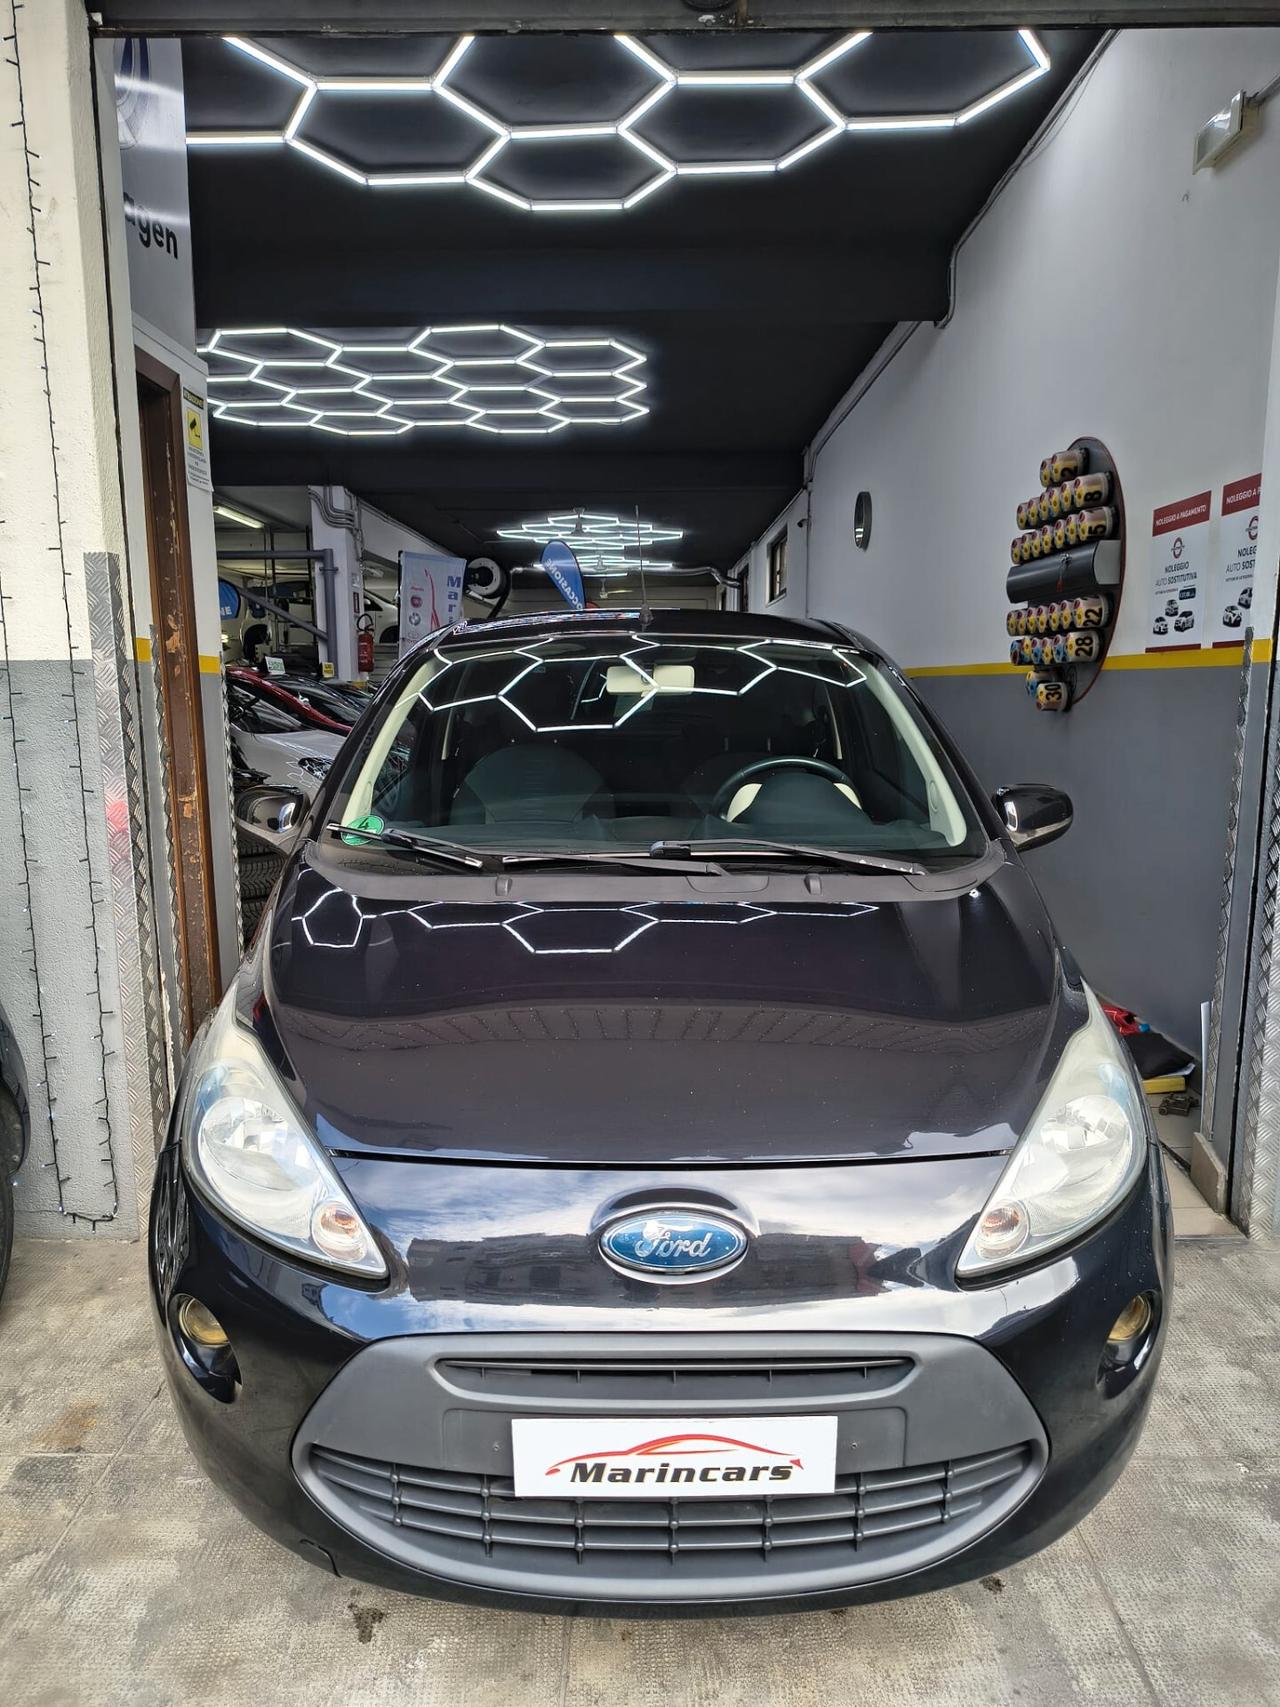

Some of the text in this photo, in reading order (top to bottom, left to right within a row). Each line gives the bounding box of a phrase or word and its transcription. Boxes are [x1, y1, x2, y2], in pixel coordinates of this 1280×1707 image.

[1226, 490, 1251, 504] NOLEGGIO
[1156, 513, 1176, 525] NOLEGGIO
[1165, 561, 1189, 573] NOLEGGIO
[1226, 563, 1241, 573] AUTO
[1075, 636, 1094, 657] 28
[1045, 683, 1062, 700] 30
[357, 817, 369, 829] 4
[634, 1220, 713, 1257] Ford
[569, 1462, 793, 1483] Marincars
